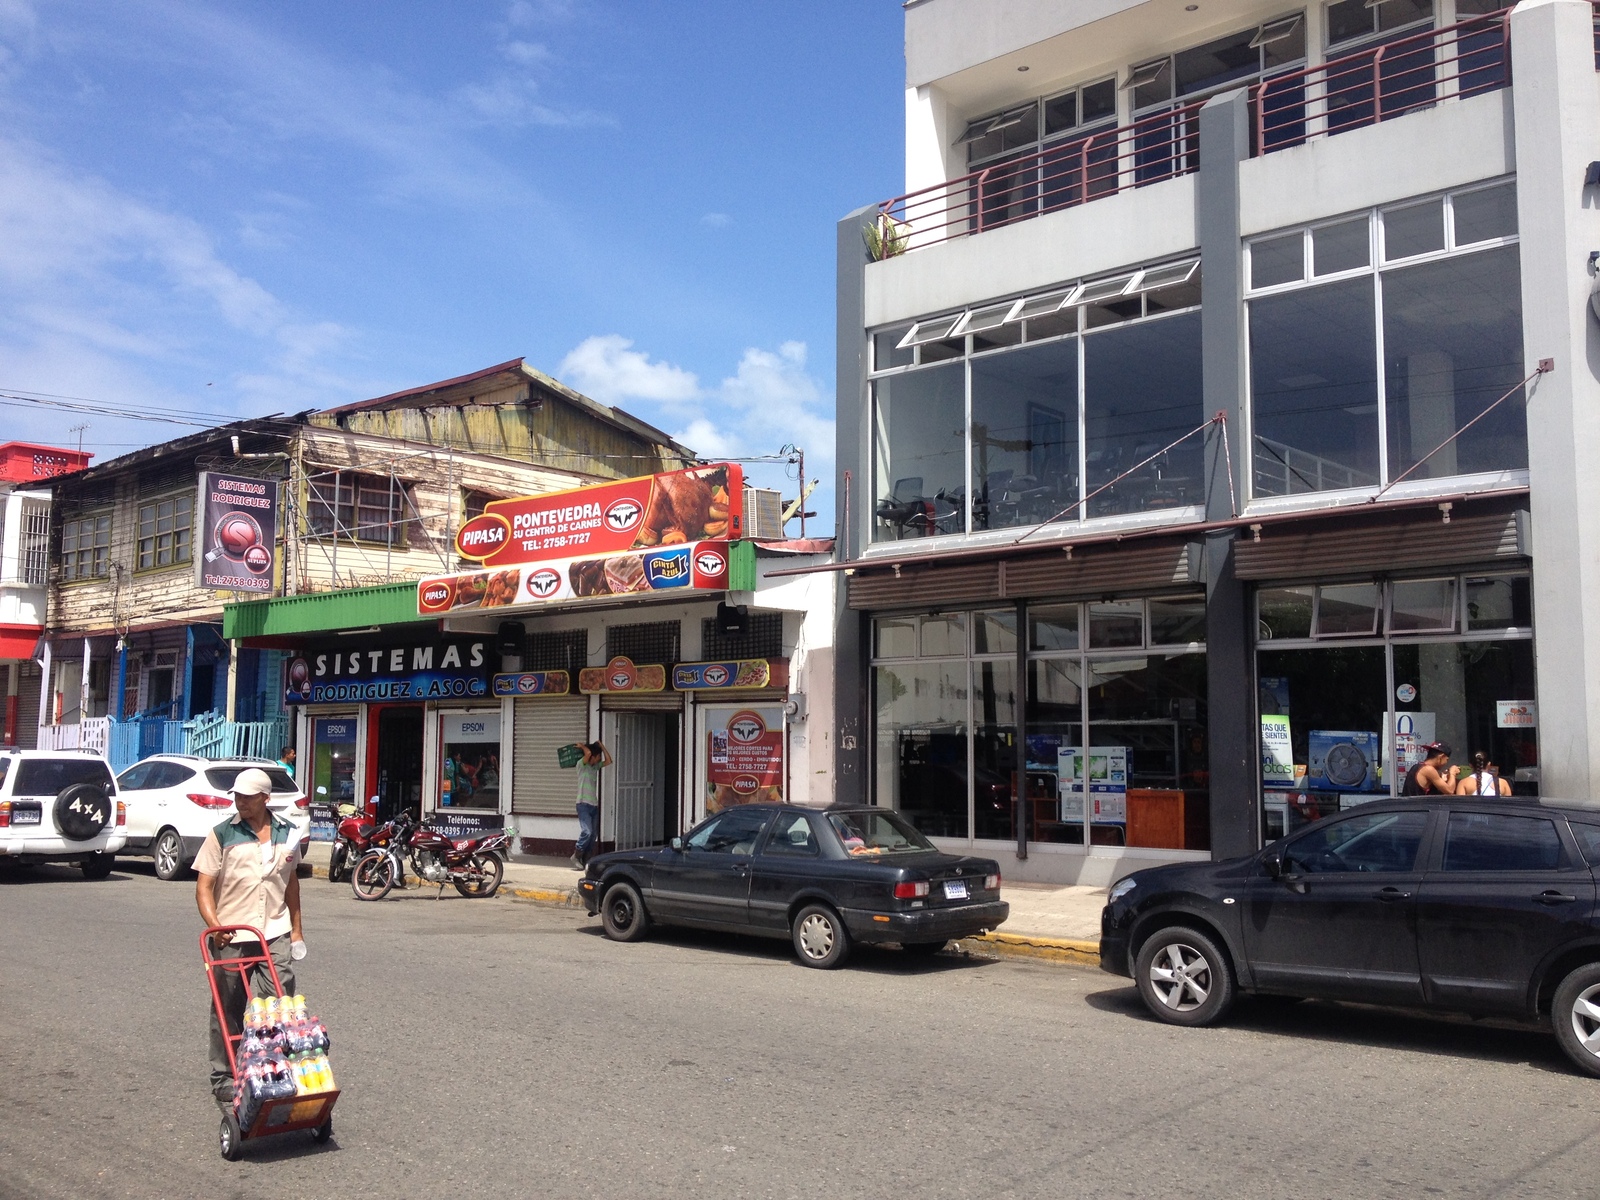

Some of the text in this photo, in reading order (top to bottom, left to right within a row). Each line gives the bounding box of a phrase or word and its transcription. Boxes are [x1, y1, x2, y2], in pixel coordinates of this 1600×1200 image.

[218, 480, 265, 494] SISTEMAS
[212, 493, 270, 508] RODRIGUEZ
[513, 502, 601, 529] PONTEVEDRA
[513, 518, 601, 539] SU CENTRO DE CARNES
[462, 527, 504, 546] PIPASA
[522, 532, 591, 551] TEL: 2758-7727
[653, 560, 675, 569] CINTA
[662, 568, 679, 577] AZUL
[425, 590, 447, 600] PIPASA
[315, 643, 484, 676] SISTEMAS
[314, 681, 411, 701] RODRIGUEZ
[416, 687, 423, 697] &
[428, 678, 484, 697] ASOC.
[327, 725, 346, 734] EPSON
[461, 723, 485, 732] EPSON
[1274, 724, 1286, 732] QUE
[69, 797, 104, 824] 4x4
[313, 809, 331, 817] Horario
[447, 815, 480, 825] Teléfonos:
